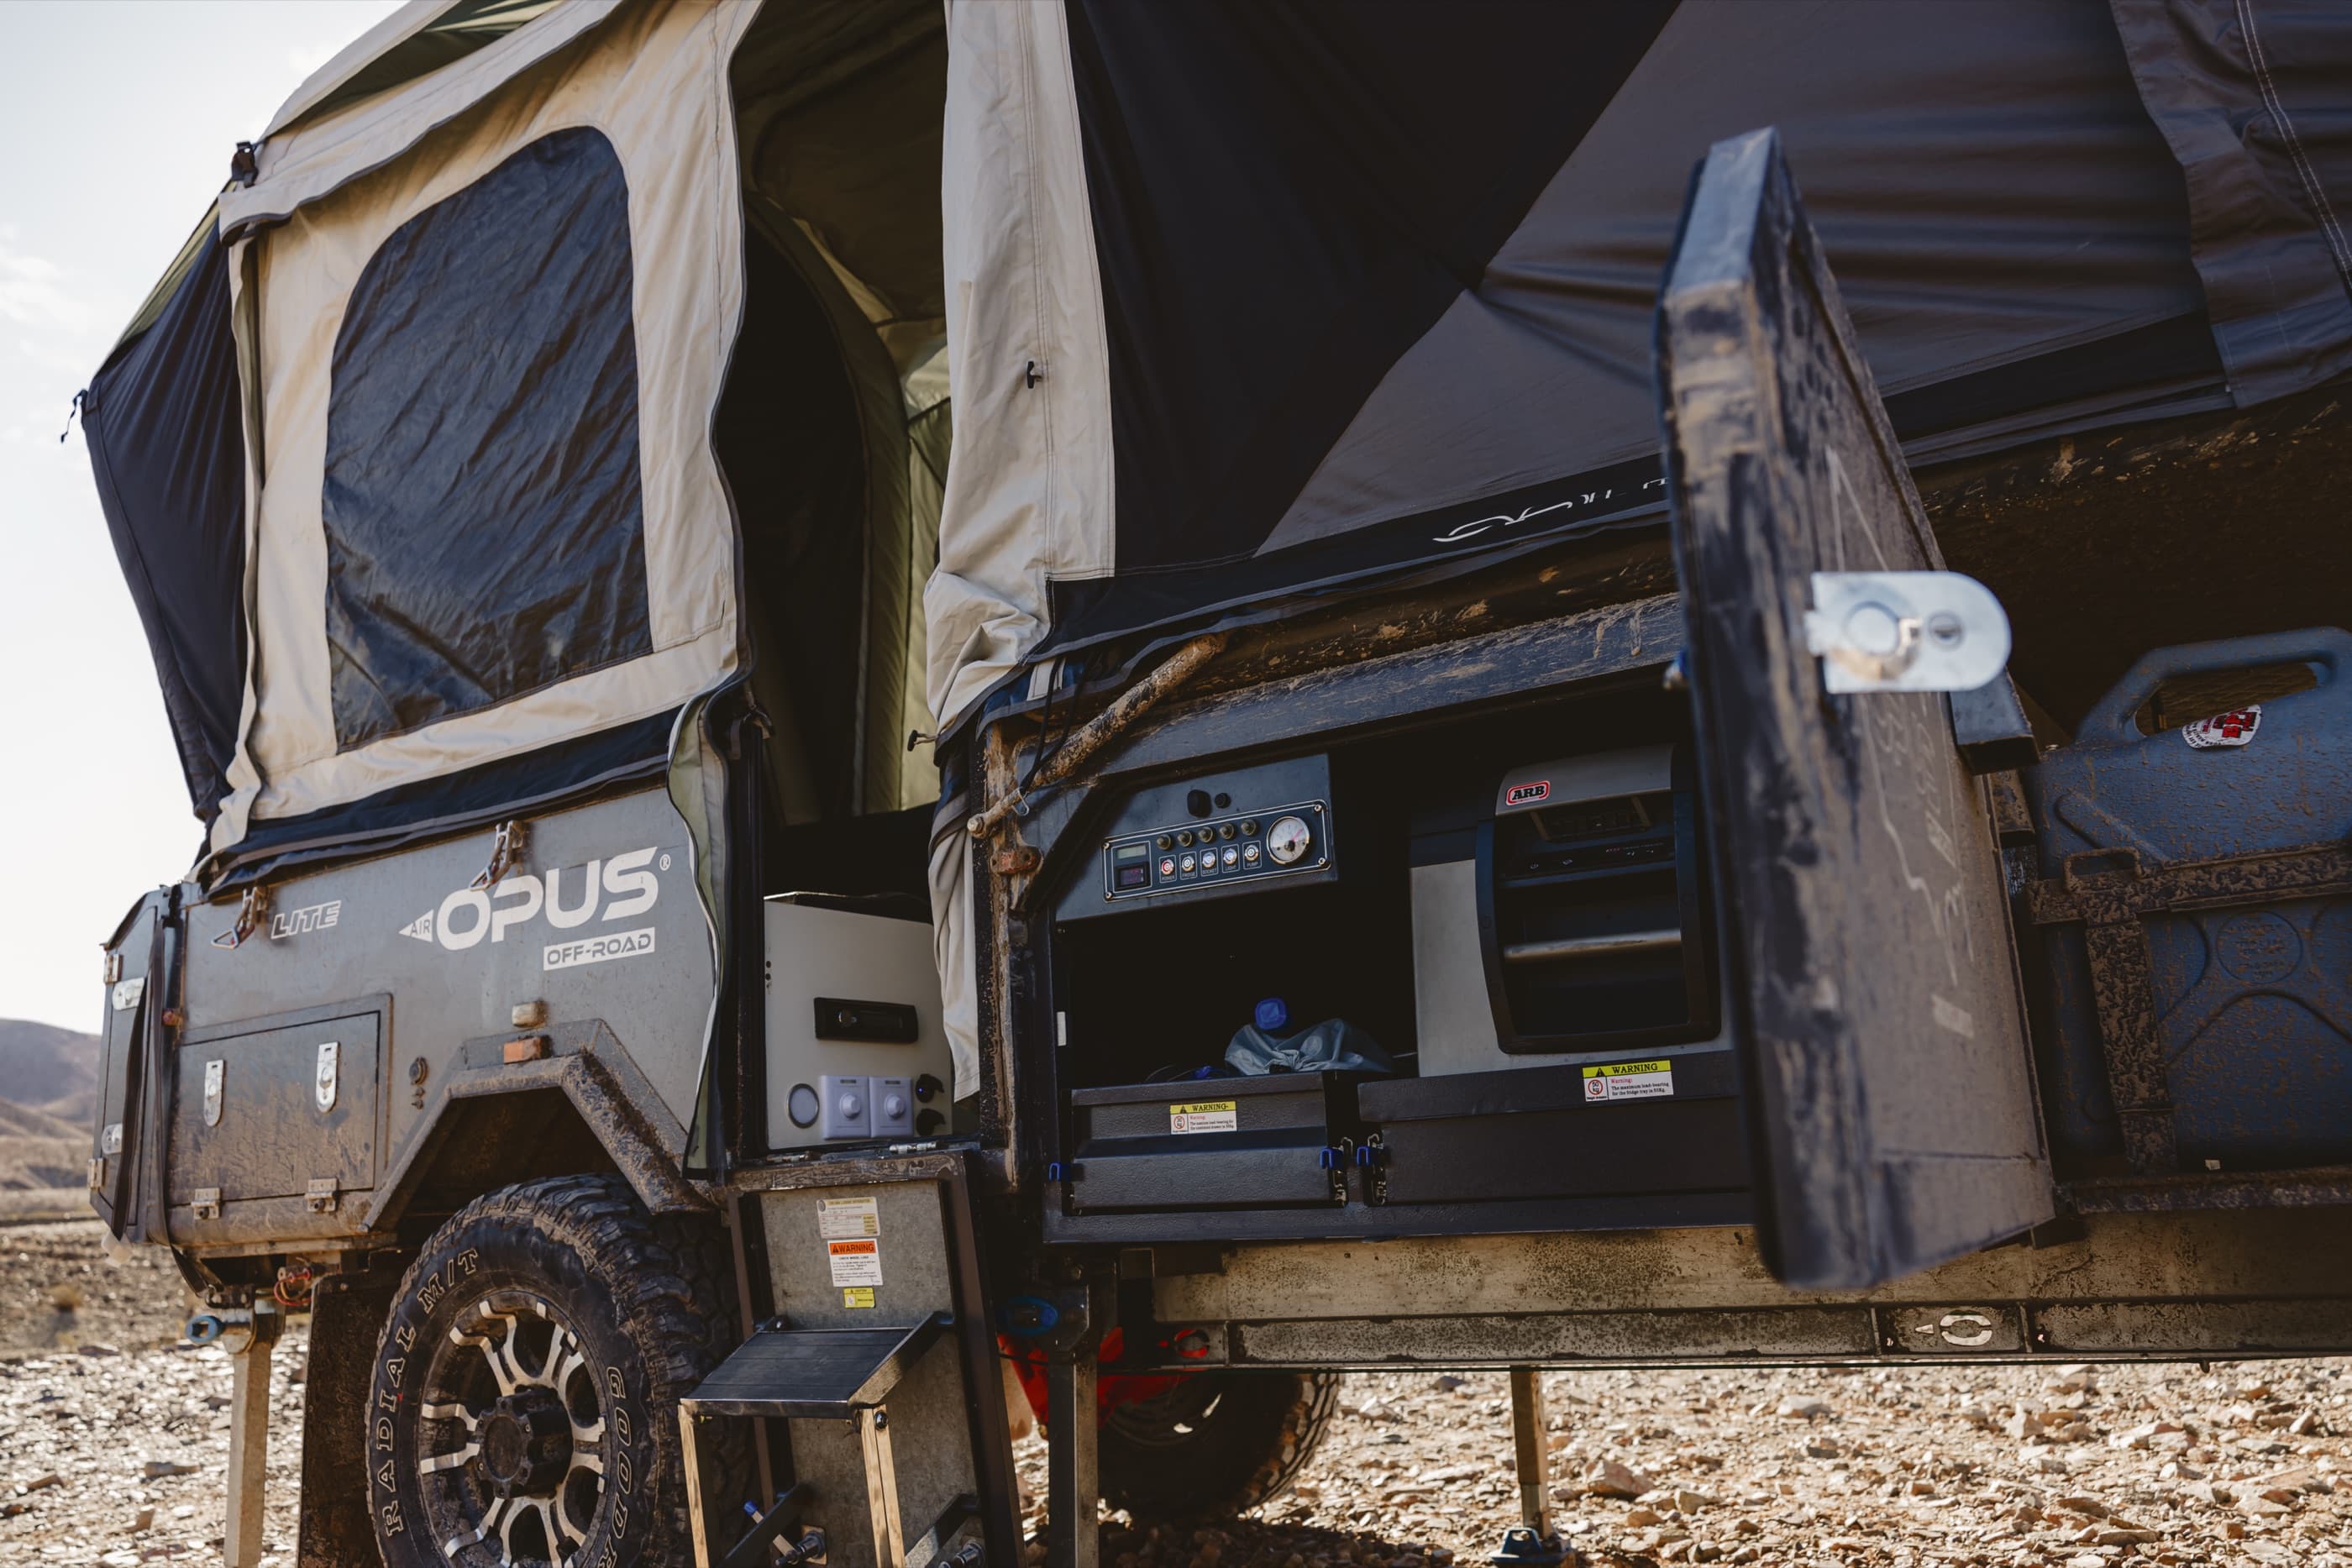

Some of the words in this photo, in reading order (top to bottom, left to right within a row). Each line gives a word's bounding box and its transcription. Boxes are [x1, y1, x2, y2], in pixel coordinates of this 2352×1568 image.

[1511, 785, 1545, 800] ARB
[270, 900, 341, 940] LITE
[409, 919, 431, 936] AIR
[547, 933, 651, 966] OFF-ROAD
[1611, 1063, 1658, 1074] WARNING
[838, 1244, 874, 1253] WARNING
[417, 1248, 478, 1314] M/T
[377, 1325, 417, 1537] RADIAL
